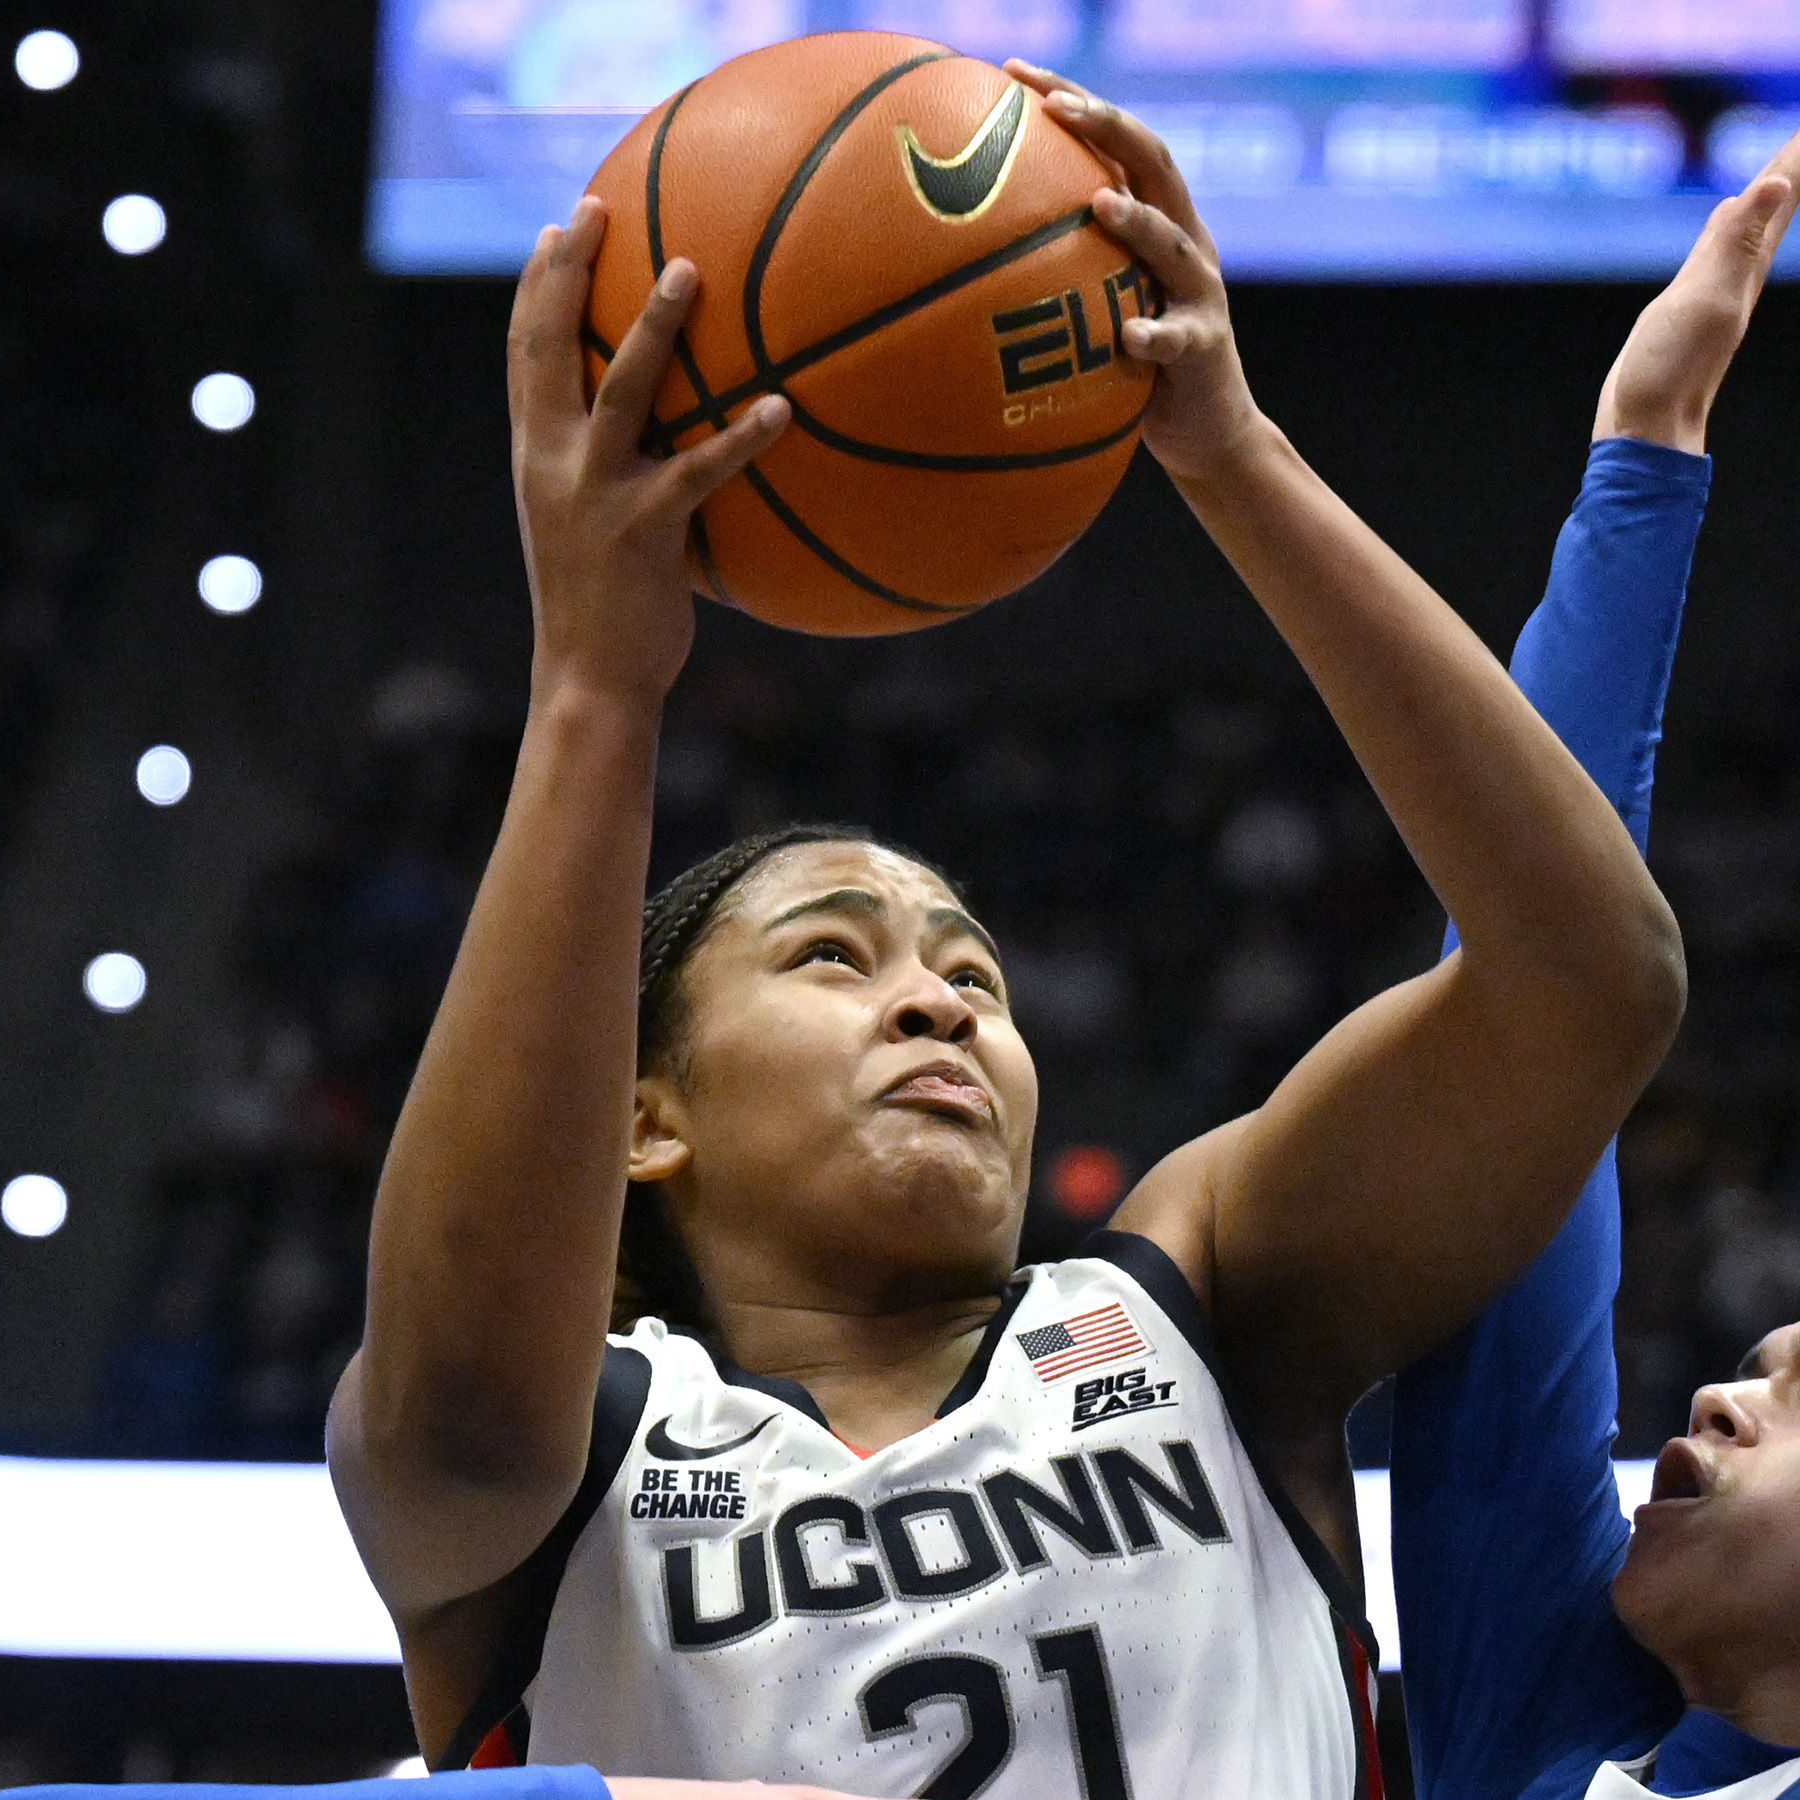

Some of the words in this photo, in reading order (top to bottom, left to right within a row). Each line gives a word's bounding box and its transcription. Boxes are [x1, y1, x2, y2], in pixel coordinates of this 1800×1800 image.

[992, 264, 1152, 393] ELIT
[1073, 1380, 1177, 1423] EAST
[1075, 1367, 1146, 1404] BIG
[641, 1468, 679, 1491] BE
[688, 1470, 741, 1492] THE
[630, 1493, 747, 1519] CHANGE
[663, 1440, 1233, 1652] UCONN
